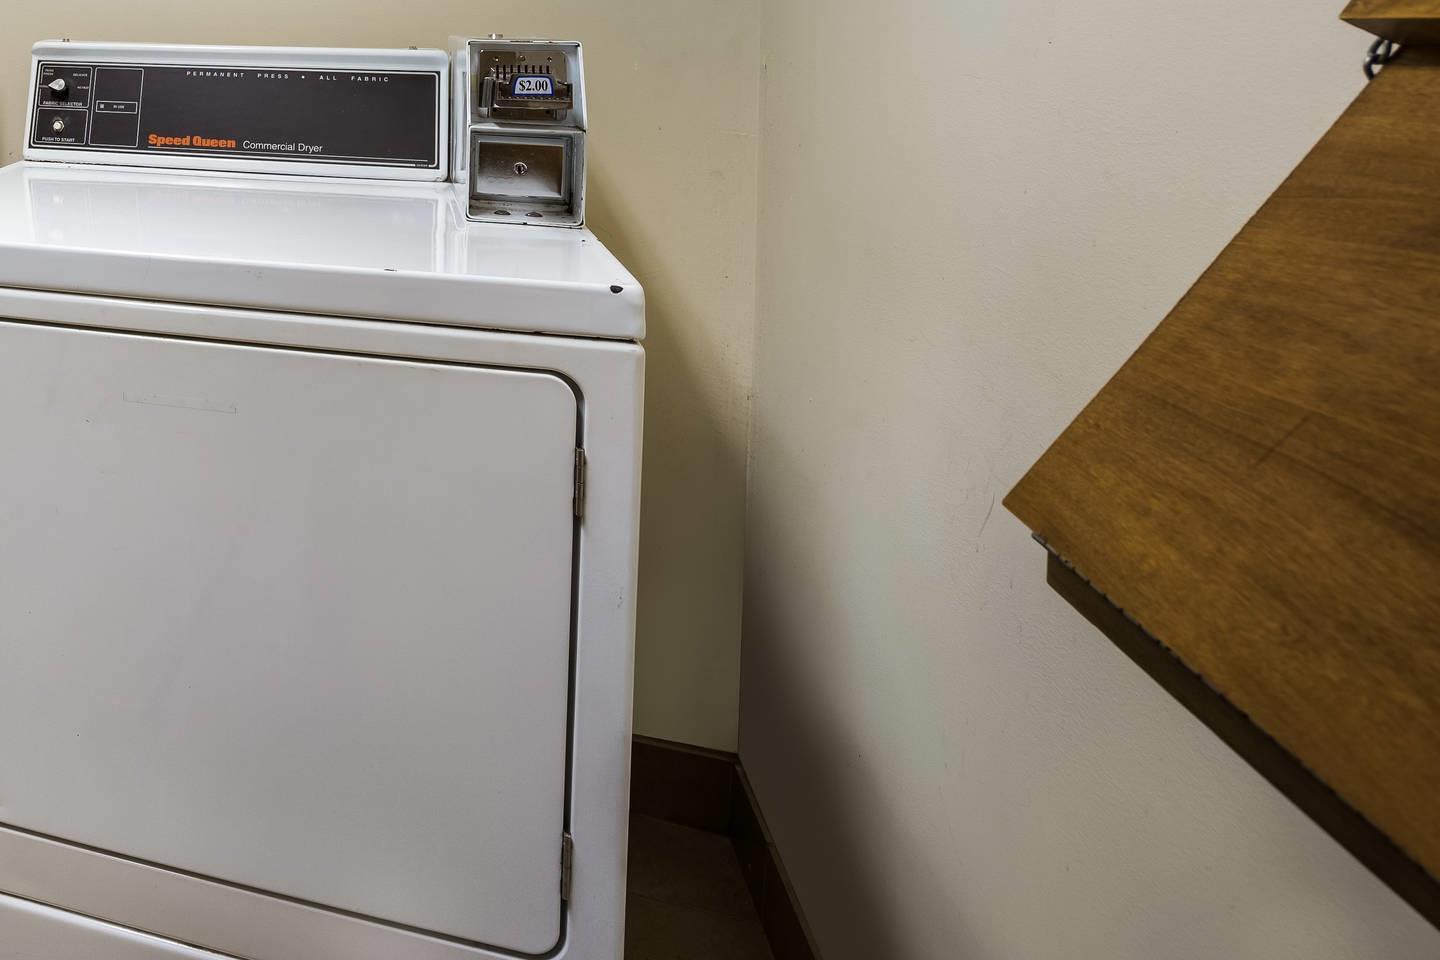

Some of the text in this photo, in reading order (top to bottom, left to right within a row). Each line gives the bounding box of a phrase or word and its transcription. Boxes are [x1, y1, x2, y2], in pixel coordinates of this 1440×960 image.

[518, 79, 548, 92] $2.00
[148, 134, 323, 154] Speed Queen Commercial Dryer
